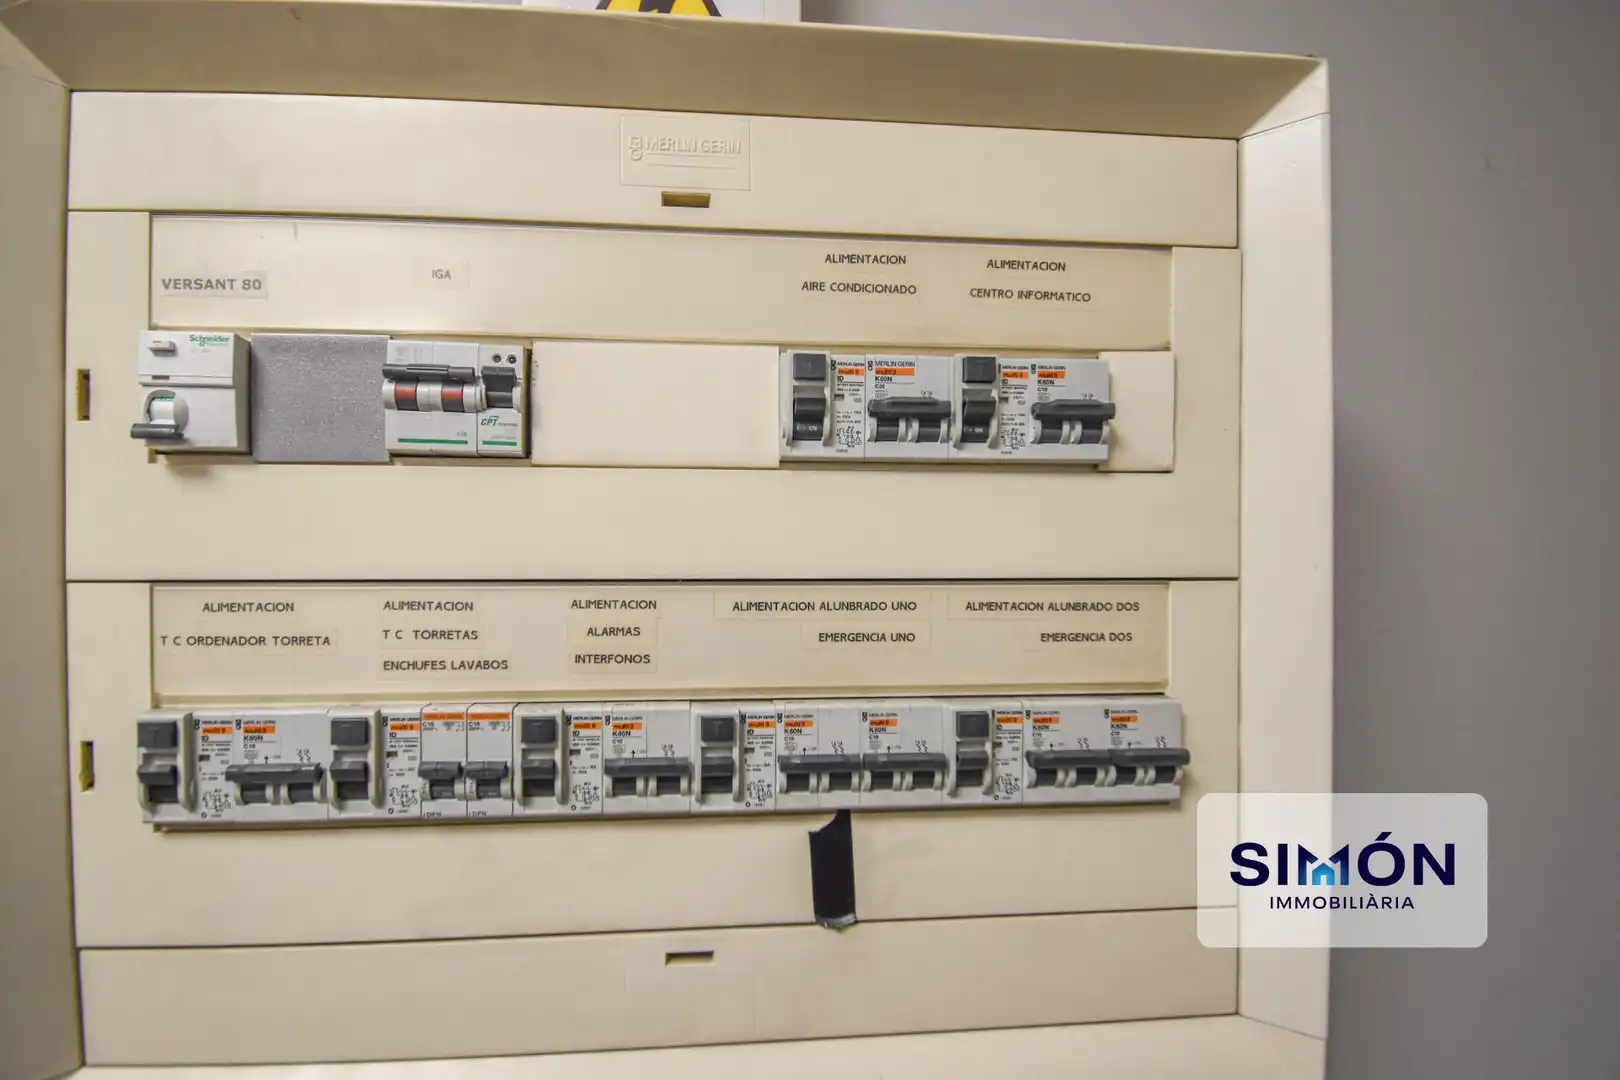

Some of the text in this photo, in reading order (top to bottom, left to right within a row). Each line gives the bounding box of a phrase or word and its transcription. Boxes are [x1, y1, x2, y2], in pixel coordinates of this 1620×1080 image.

[646, 135, 741, 155] MERLIN GERIN
[824, 253, 907, 266] ALIMENTACION
[986, 259, 1066, 272] ALIMENTACION
[431, 268, 452, 280] IGA
[161, 278, 262, 291] VERSANT 80
[801, 281, 917, 295] AIRE CONDICIONADO
[969, 288, 1092, 303] CENTRO INFORMATICO
[189, 334, 230, 347] Schneider
[202, 601, 295, 613] ALIMENTACION
[383, 600, 474, 612] ALIMENTACION
[570, 599, 658, 611] ALIMENTACION
[732, 601, 917, 612] ALIMENTACION ALUNBRADO UNO
[965, 601, 1140, 612] ALIMENTACION ALUNBRADO DOS
[382, 629, 479, 641] T C TORRETAS
[586, 626, 641, 637] ALARMAS
[818, 632, 916, 643] EMERGENCIA UNO
[1040, 632, 1133, 643] EMERGENCIA DOS
[160, 635, 331, 647] T C ORDENADOR TORRETA
[383, 659, 509, 671] ENCHUFES LAVABOS
[574, 653, 651, 665] INTERFONOS
